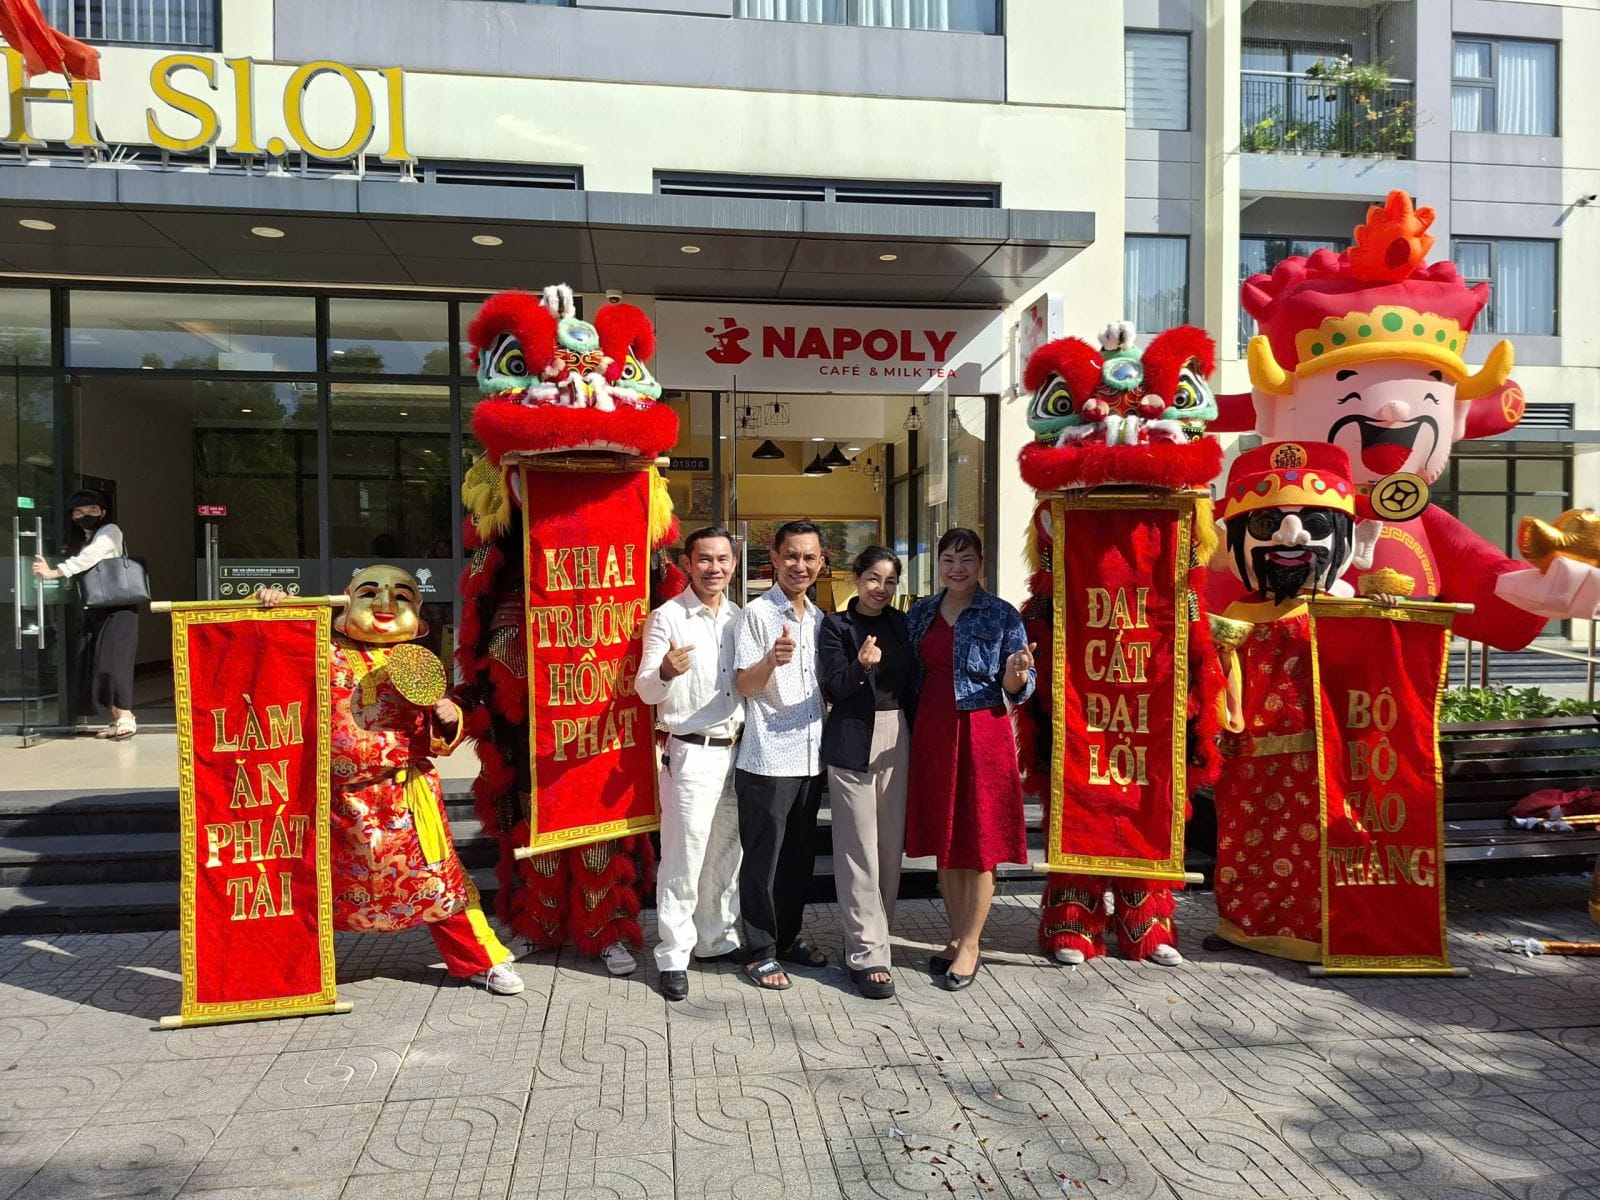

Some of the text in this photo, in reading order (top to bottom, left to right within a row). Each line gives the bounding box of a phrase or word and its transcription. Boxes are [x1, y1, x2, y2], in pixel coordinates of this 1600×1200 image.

[763, 325, 957, 363] NAPOLY
[819, 364, 957, 378] CAFÉ & MILK TEA
[544, 544, 635, 591] KHAI
[531, 596, 647, 648] TRƯƠNG
[1086, 587, 1149, 635] ĐẠI
[548, 648, 637, 706] HỒNG
[1085, 634, 1151, 682] CÁT
[211, 693, 304, 752] LÀM
[552, 702, 638, 761] PHÁT
[1086, 693, 1149, 739] ĐẠI
[230, 759, 290, 808] ĂN
[1088, 737, 1149, 792] LỢI
[1347, 736, 1398, 785] BỘ
[1343, 790, 1406, 832] CAO
[204, 804, 311, 868] PHÁT
[1328, 839, 1436, 887] THĂNG
[226, 863, 294, 921] TÀI
